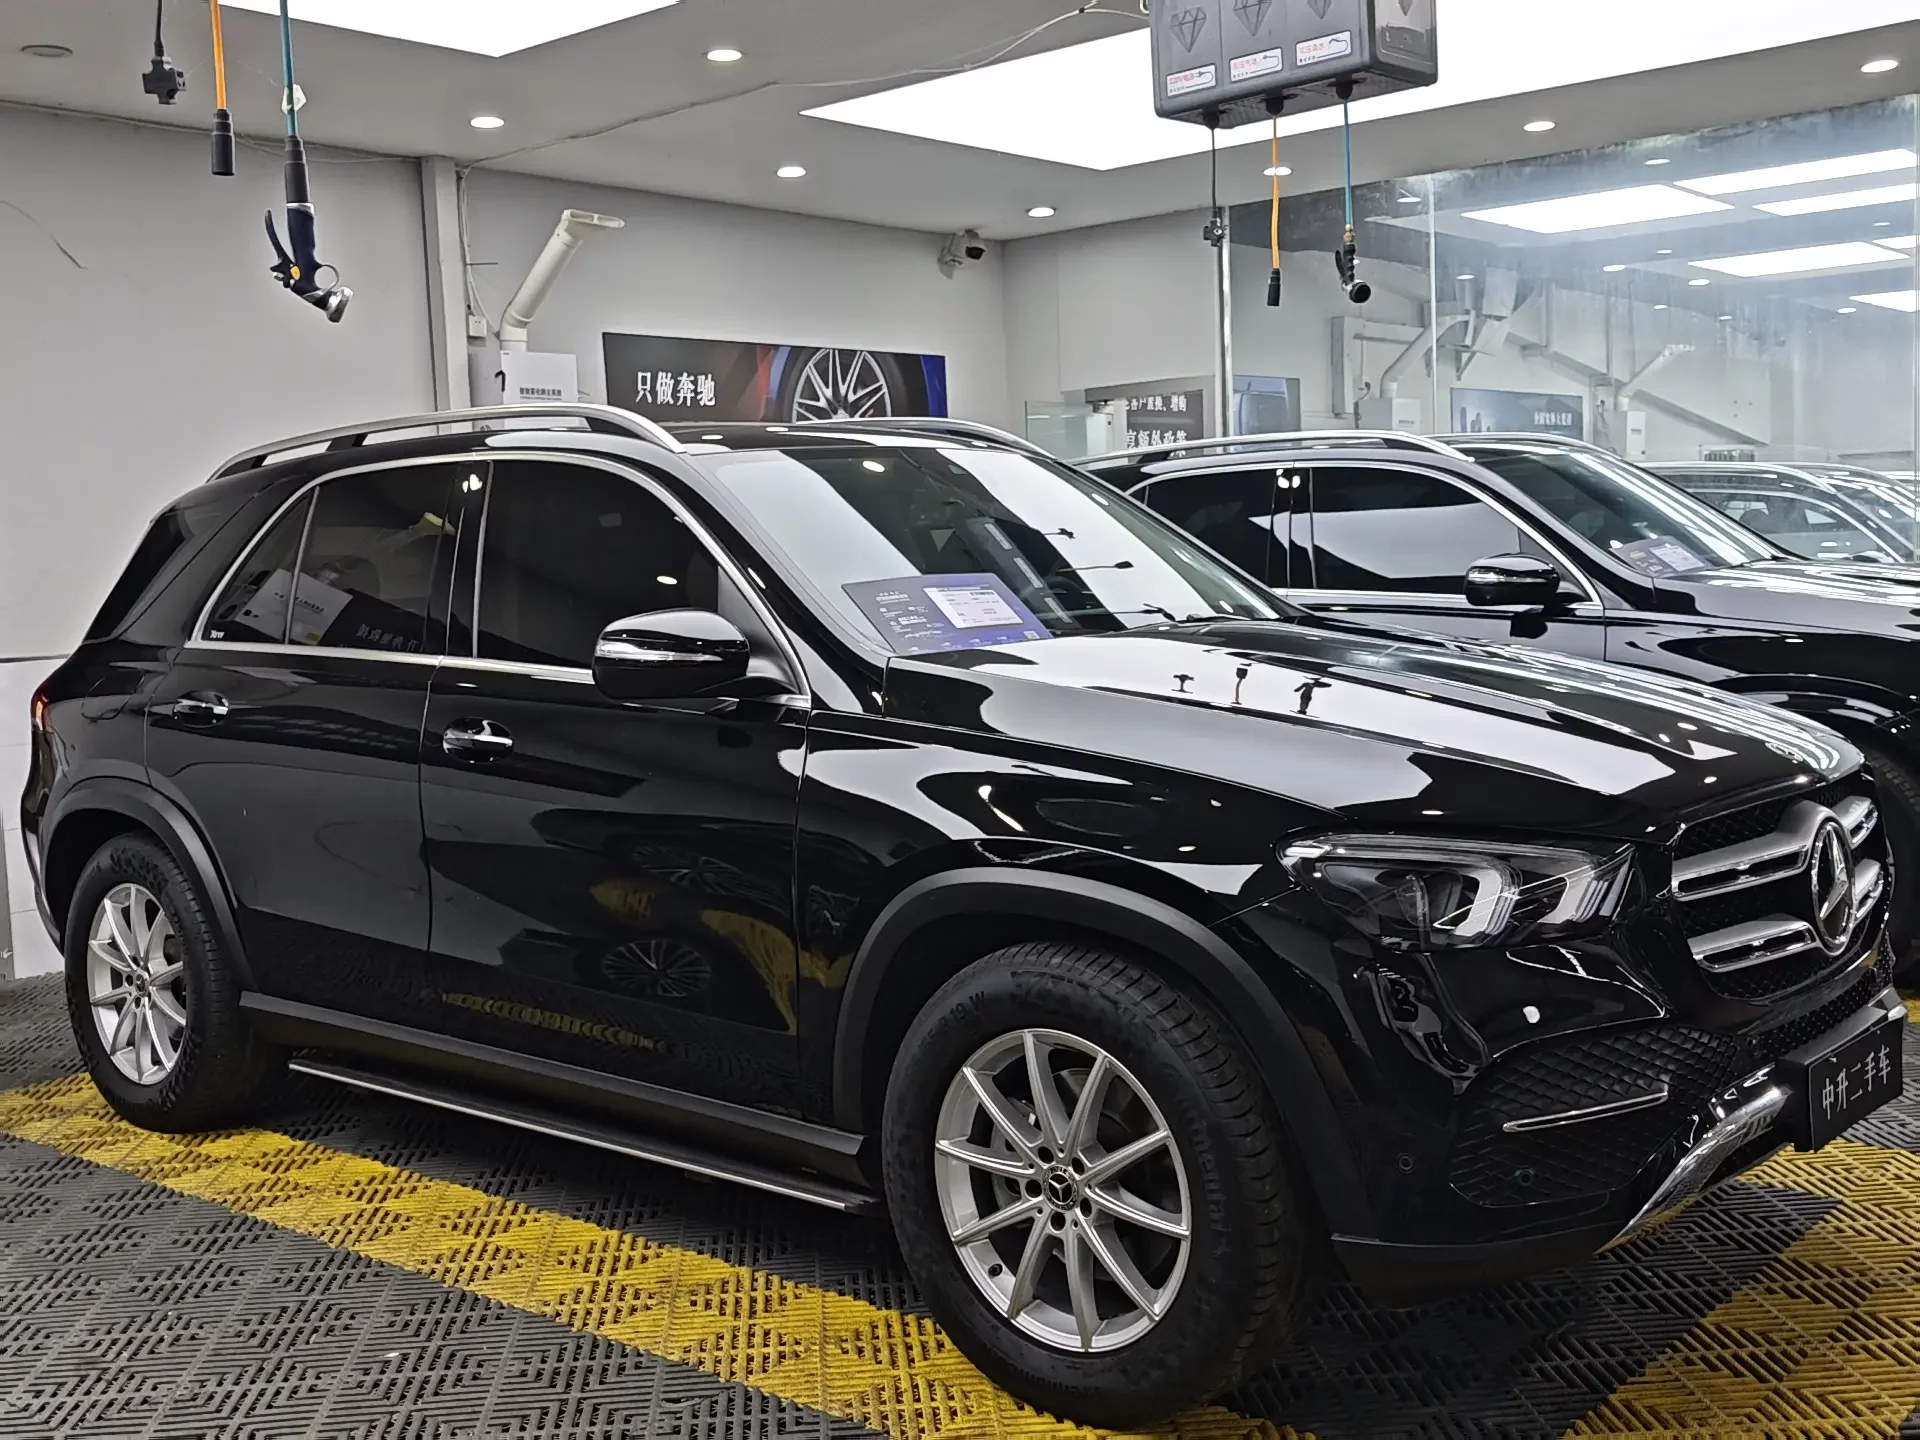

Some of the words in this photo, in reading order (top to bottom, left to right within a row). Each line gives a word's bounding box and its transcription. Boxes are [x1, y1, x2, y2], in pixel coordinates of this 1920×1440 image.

[635, 370, 716, 407] 只做奔驰
[1821, 1043, 1892, 1121] 中升二手车
